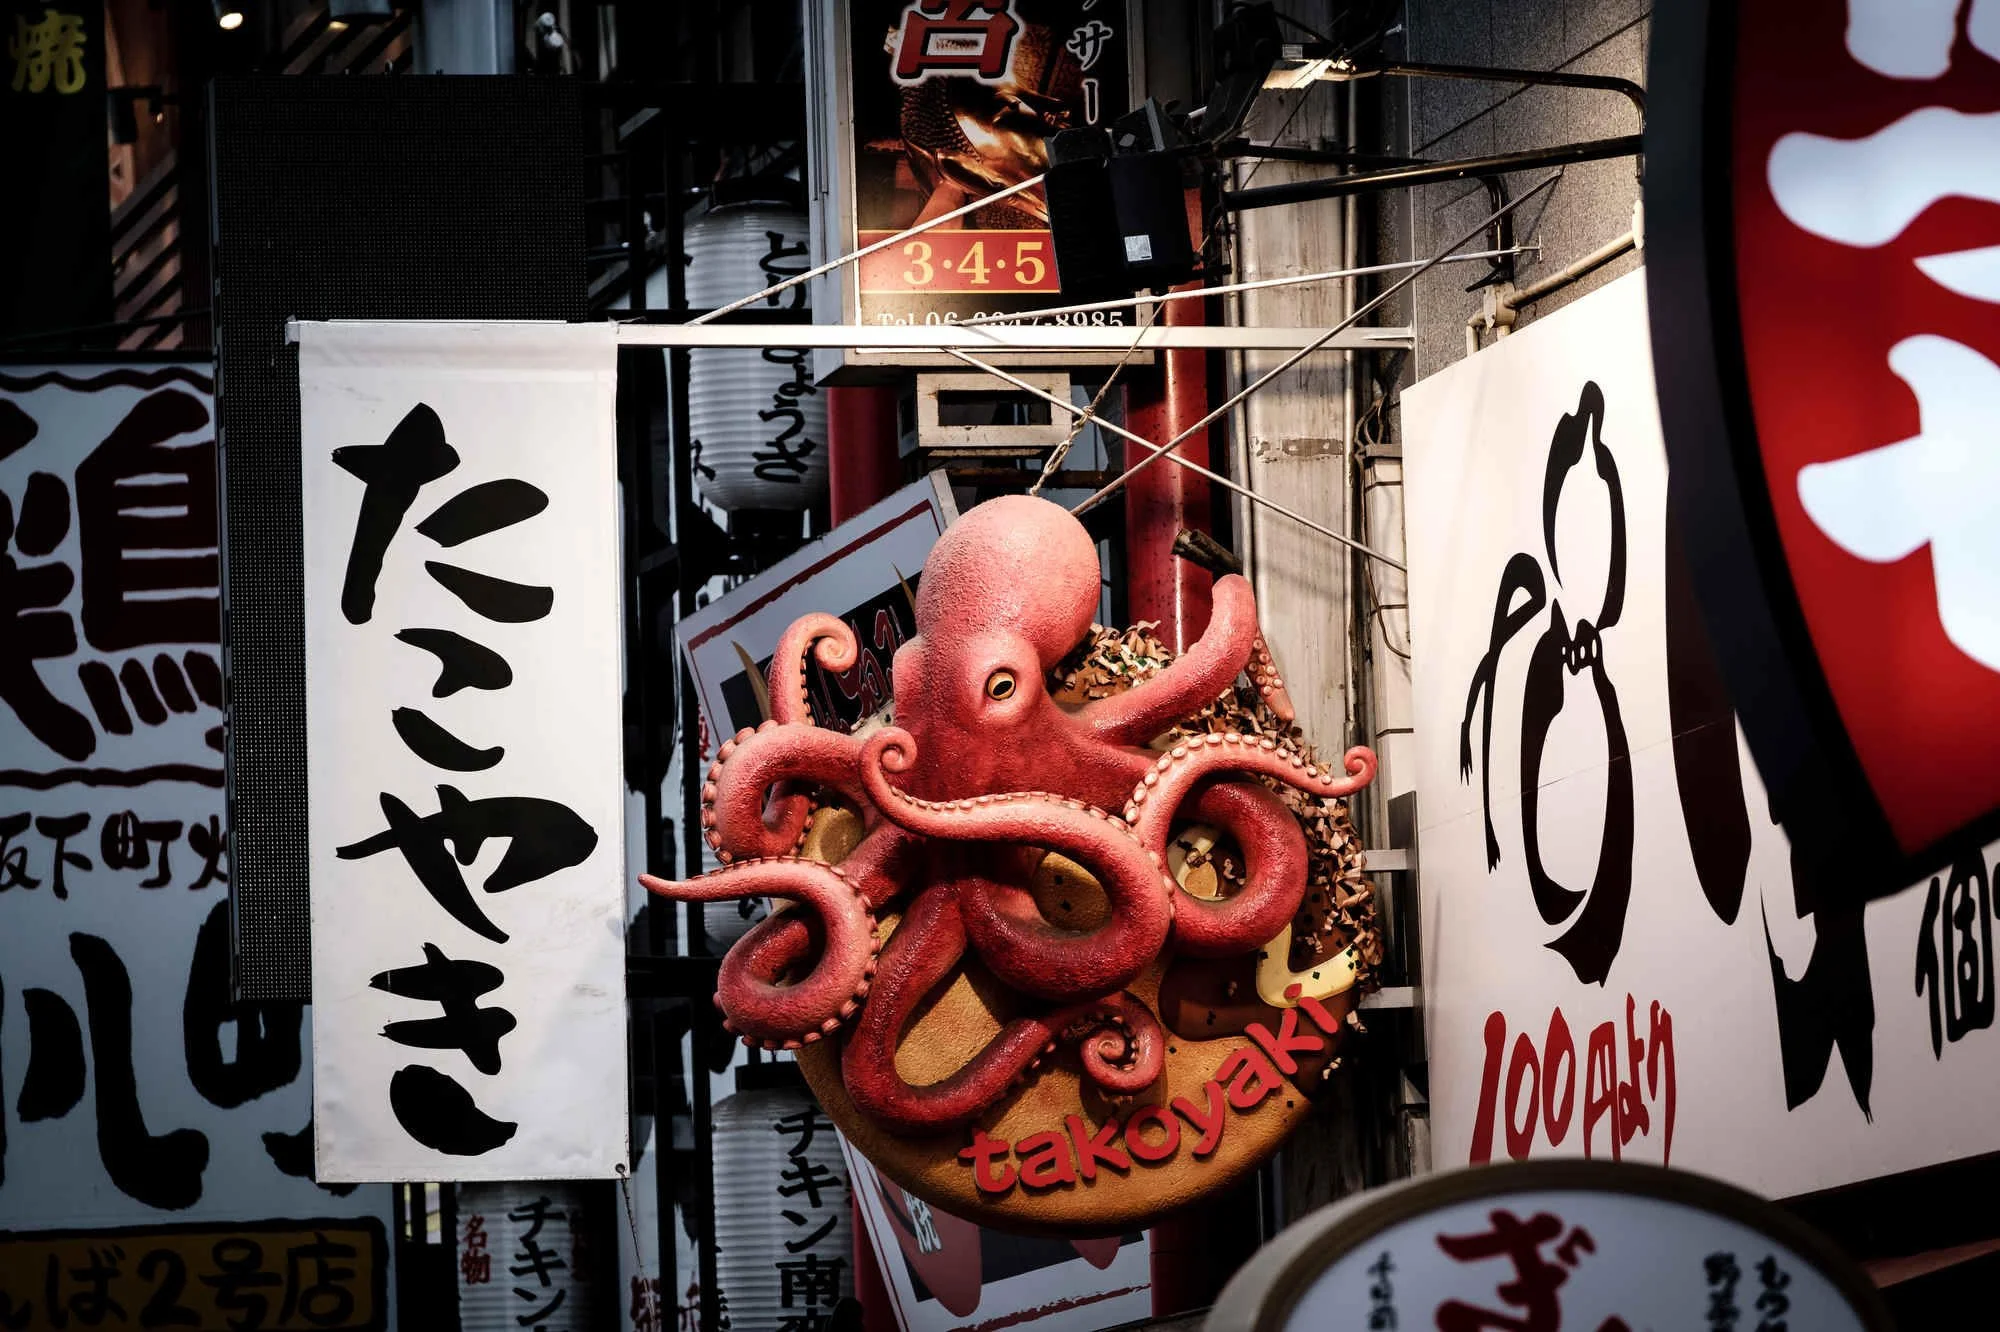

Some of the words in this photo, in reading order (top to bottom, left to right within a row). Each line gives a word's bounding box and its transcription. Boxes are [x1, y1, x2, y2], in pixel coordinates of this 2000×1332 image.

[1066, 0, 1114, 125] サー
[331, 402, 599, 1157] たこやき
[957, 982, 1340, 1195] takoyaki
[461, 1214, 491, 1285] 名物
[508, 1196, 567, 1332] チキン
